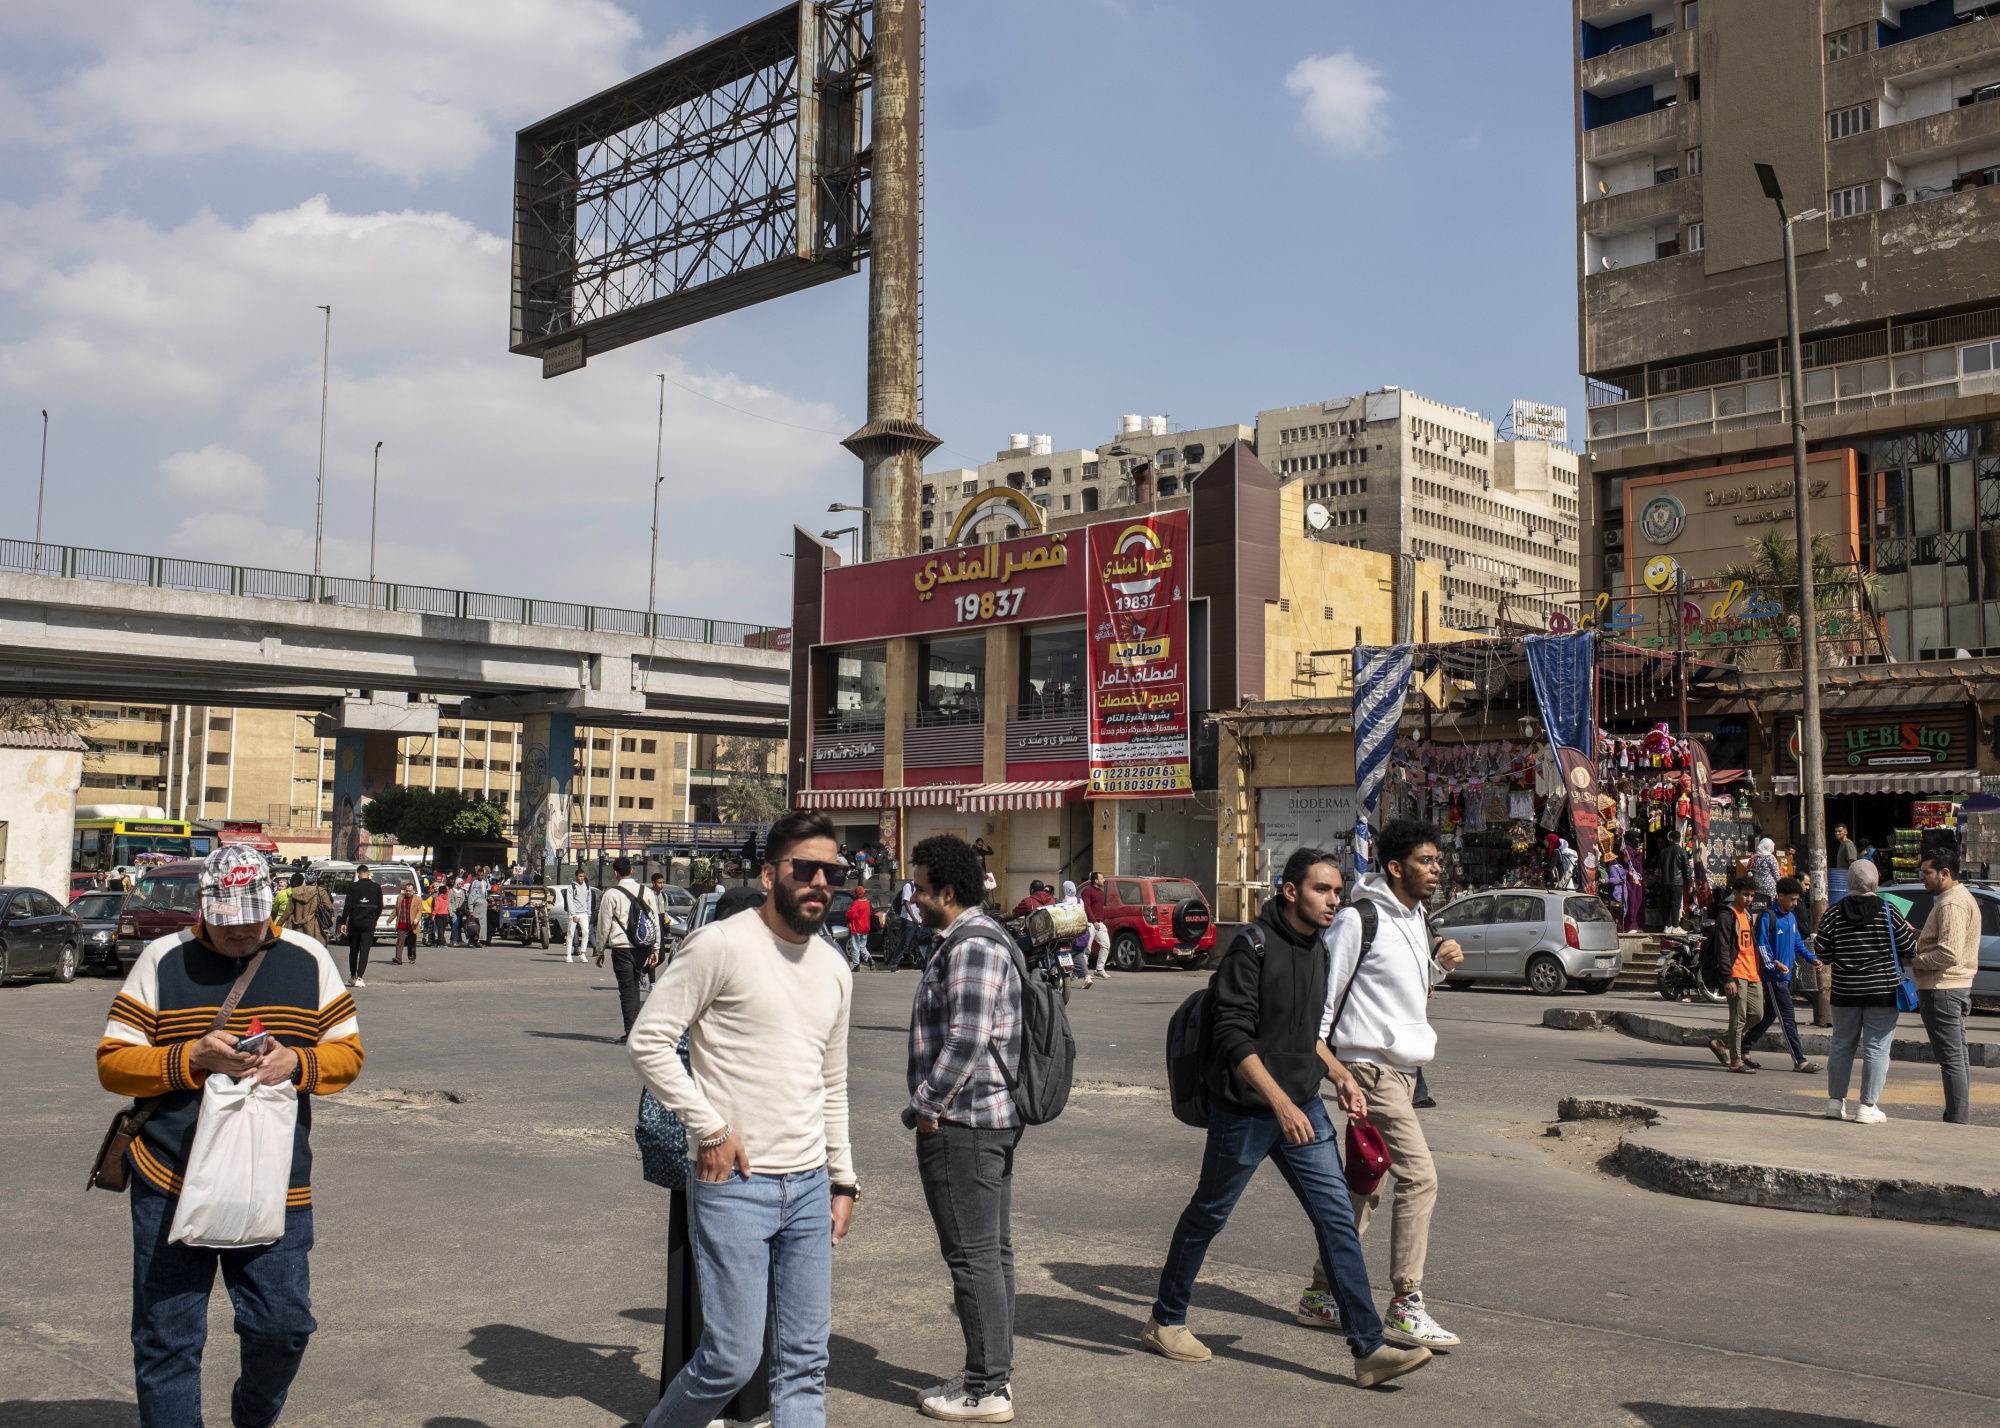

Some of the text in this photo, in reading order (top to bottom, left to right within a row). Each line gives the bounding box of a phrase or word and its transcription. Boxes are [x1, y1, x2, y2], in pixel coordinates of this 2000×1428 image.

[1807, 478, 1829, 498] جها
[914, 532, 1068, 601] قصر المندي
[1144, 548, 1173, 577] قصر
[954, 587, 1026, 623] 19837
[1116, 593, 1156, 610] 19837
[1116, 643, 1162, 662] مطلوب
[1148, 691, 1180, 708] جميع
[1716, 726, 1742, 734] GIFTS
[1288, 798, 1350, 808] BIODERMA
[222, 990, 242, 1018] POLO
